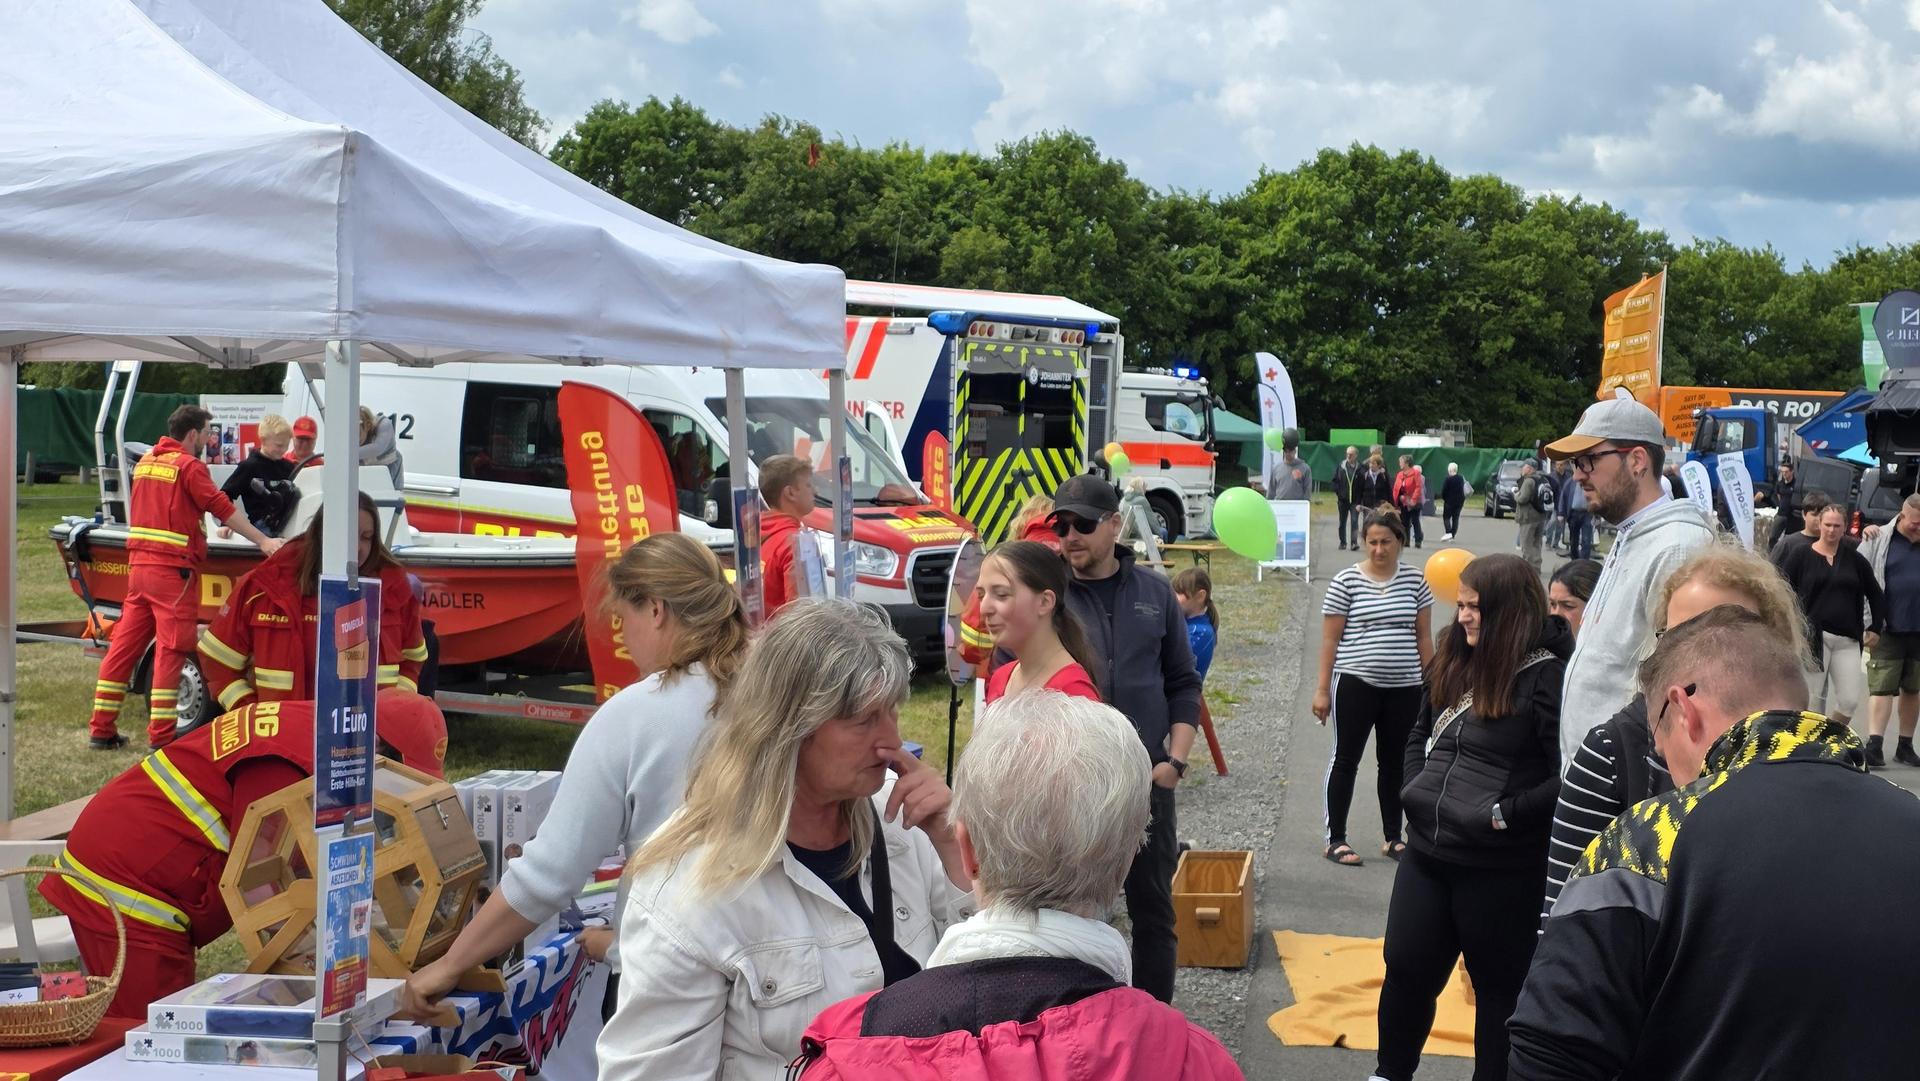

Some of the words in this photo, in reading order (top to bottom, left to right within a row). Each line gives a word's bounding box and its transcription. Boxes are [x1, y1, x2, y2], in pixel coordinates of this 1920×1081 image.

[376, 411, 415, 440] 12
[257, 613, 289, 623] DLRG
[341, 616, 364, 633] TOMBOLA
[527, 703, 573, 719] Ohlmeier
[255, 702, 281, 737] RG
[331, 708, 338, 735] 1
[342, 706, 368, 734] Euro
[330, 778, 345, 791] Erste
[175, 1021, 204, 1031] 1000
[153, 1049, 181, 1058] 1000
